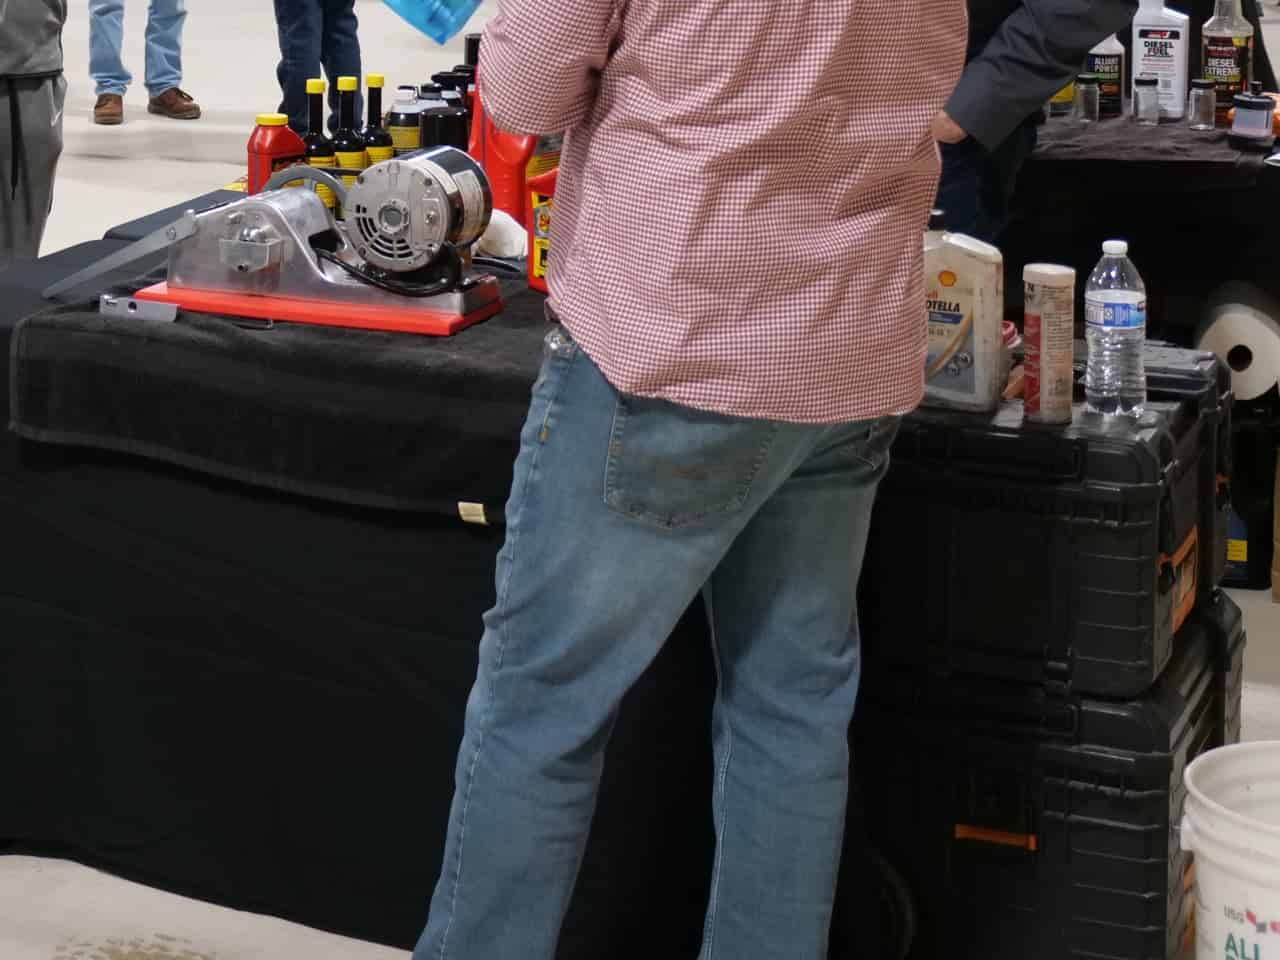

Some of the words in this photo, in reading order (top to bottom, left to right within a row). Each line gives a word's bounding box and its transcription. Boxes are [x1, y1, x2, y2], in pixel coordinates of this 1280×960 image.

[1143, 40, 1175, 49] DIESEL
[1147, 48, 1169, 56] FUEL
[926, 300, 960, 312] OTELLA
